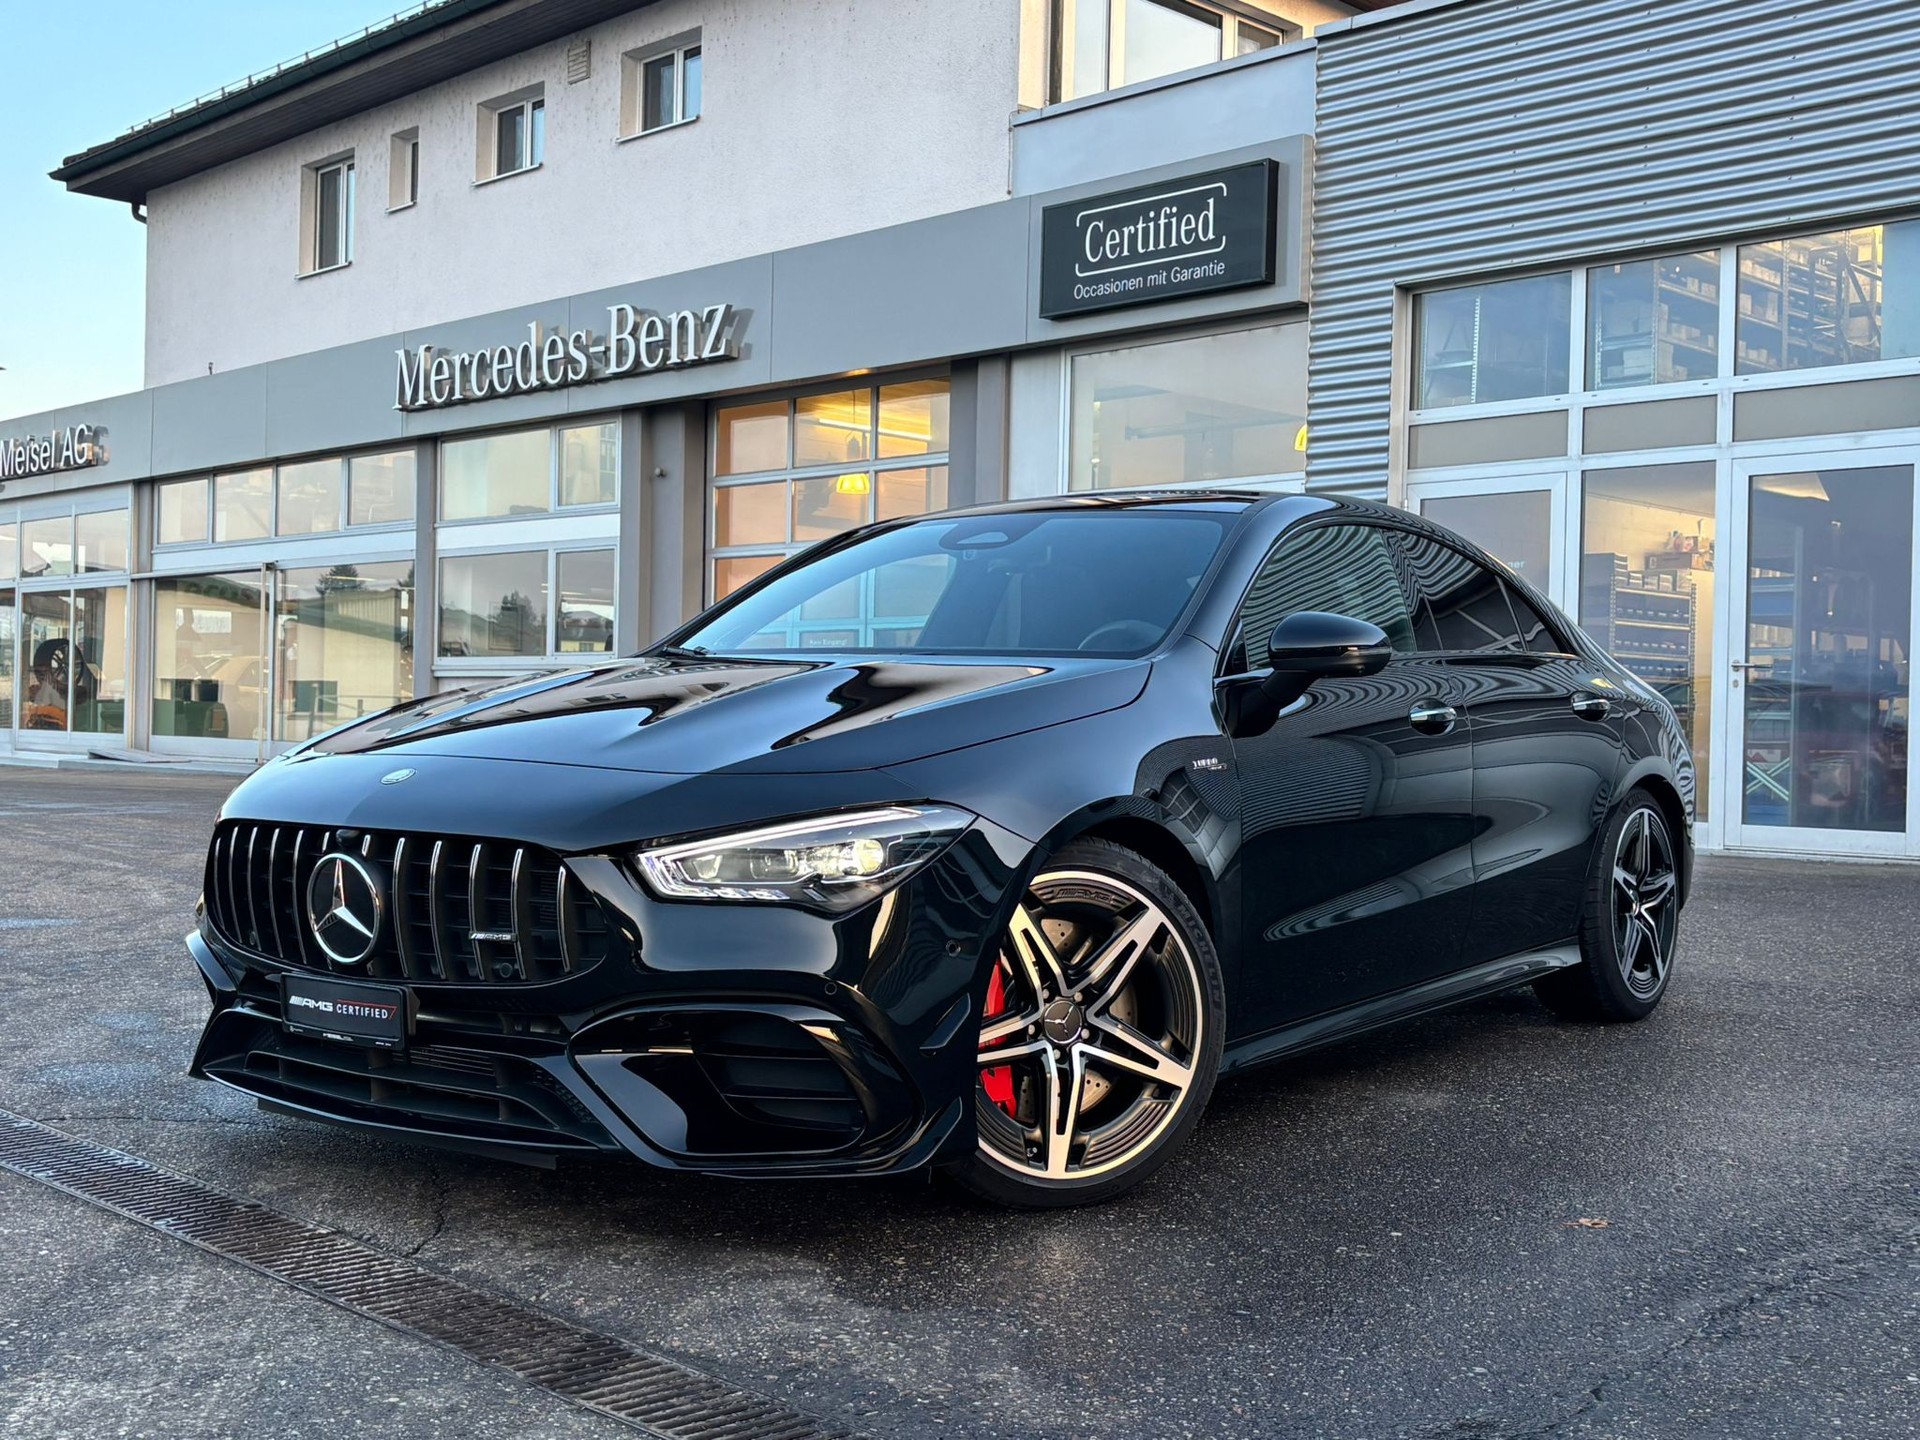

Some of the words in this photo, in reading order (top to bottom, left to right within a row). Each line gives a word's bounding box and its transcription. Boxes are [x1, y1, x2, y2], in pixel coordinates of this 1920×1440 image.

[1085, 197, 1216, 263] Certified
[1073, 276, 1144, 300] Occasionen
[1146, 269, 1167, 287] mit
[1170, 259, 1226, 283] Garantie
[392, 303, 733, 411] Mercedes-Benz
[0, 430, 56, 476] Meisel
[60, 423, 90, 467] AG
[301, 998, 334, 1012] AMG
[336, 1003, 389, 1019] CERTIFIED
